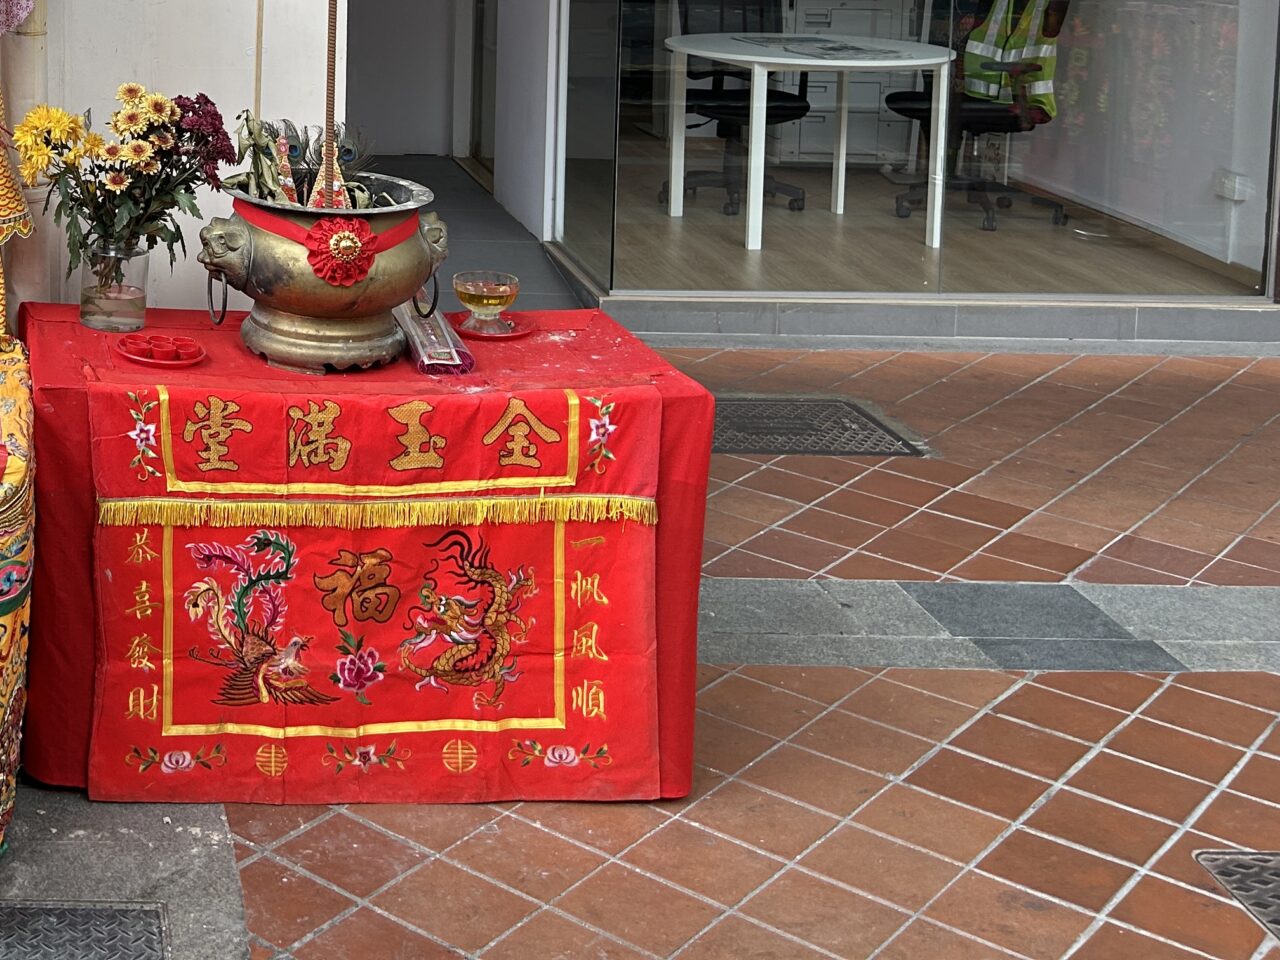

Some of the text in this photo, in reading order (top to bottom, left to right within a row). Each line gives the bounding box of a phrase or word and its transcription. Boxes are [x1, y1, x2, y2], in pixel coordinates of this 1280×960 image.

[124, 528, 162, 721] 恭喜發財
[313, 548, 402, 627] 福
[570, 536, 609, 721] 一帆風順
